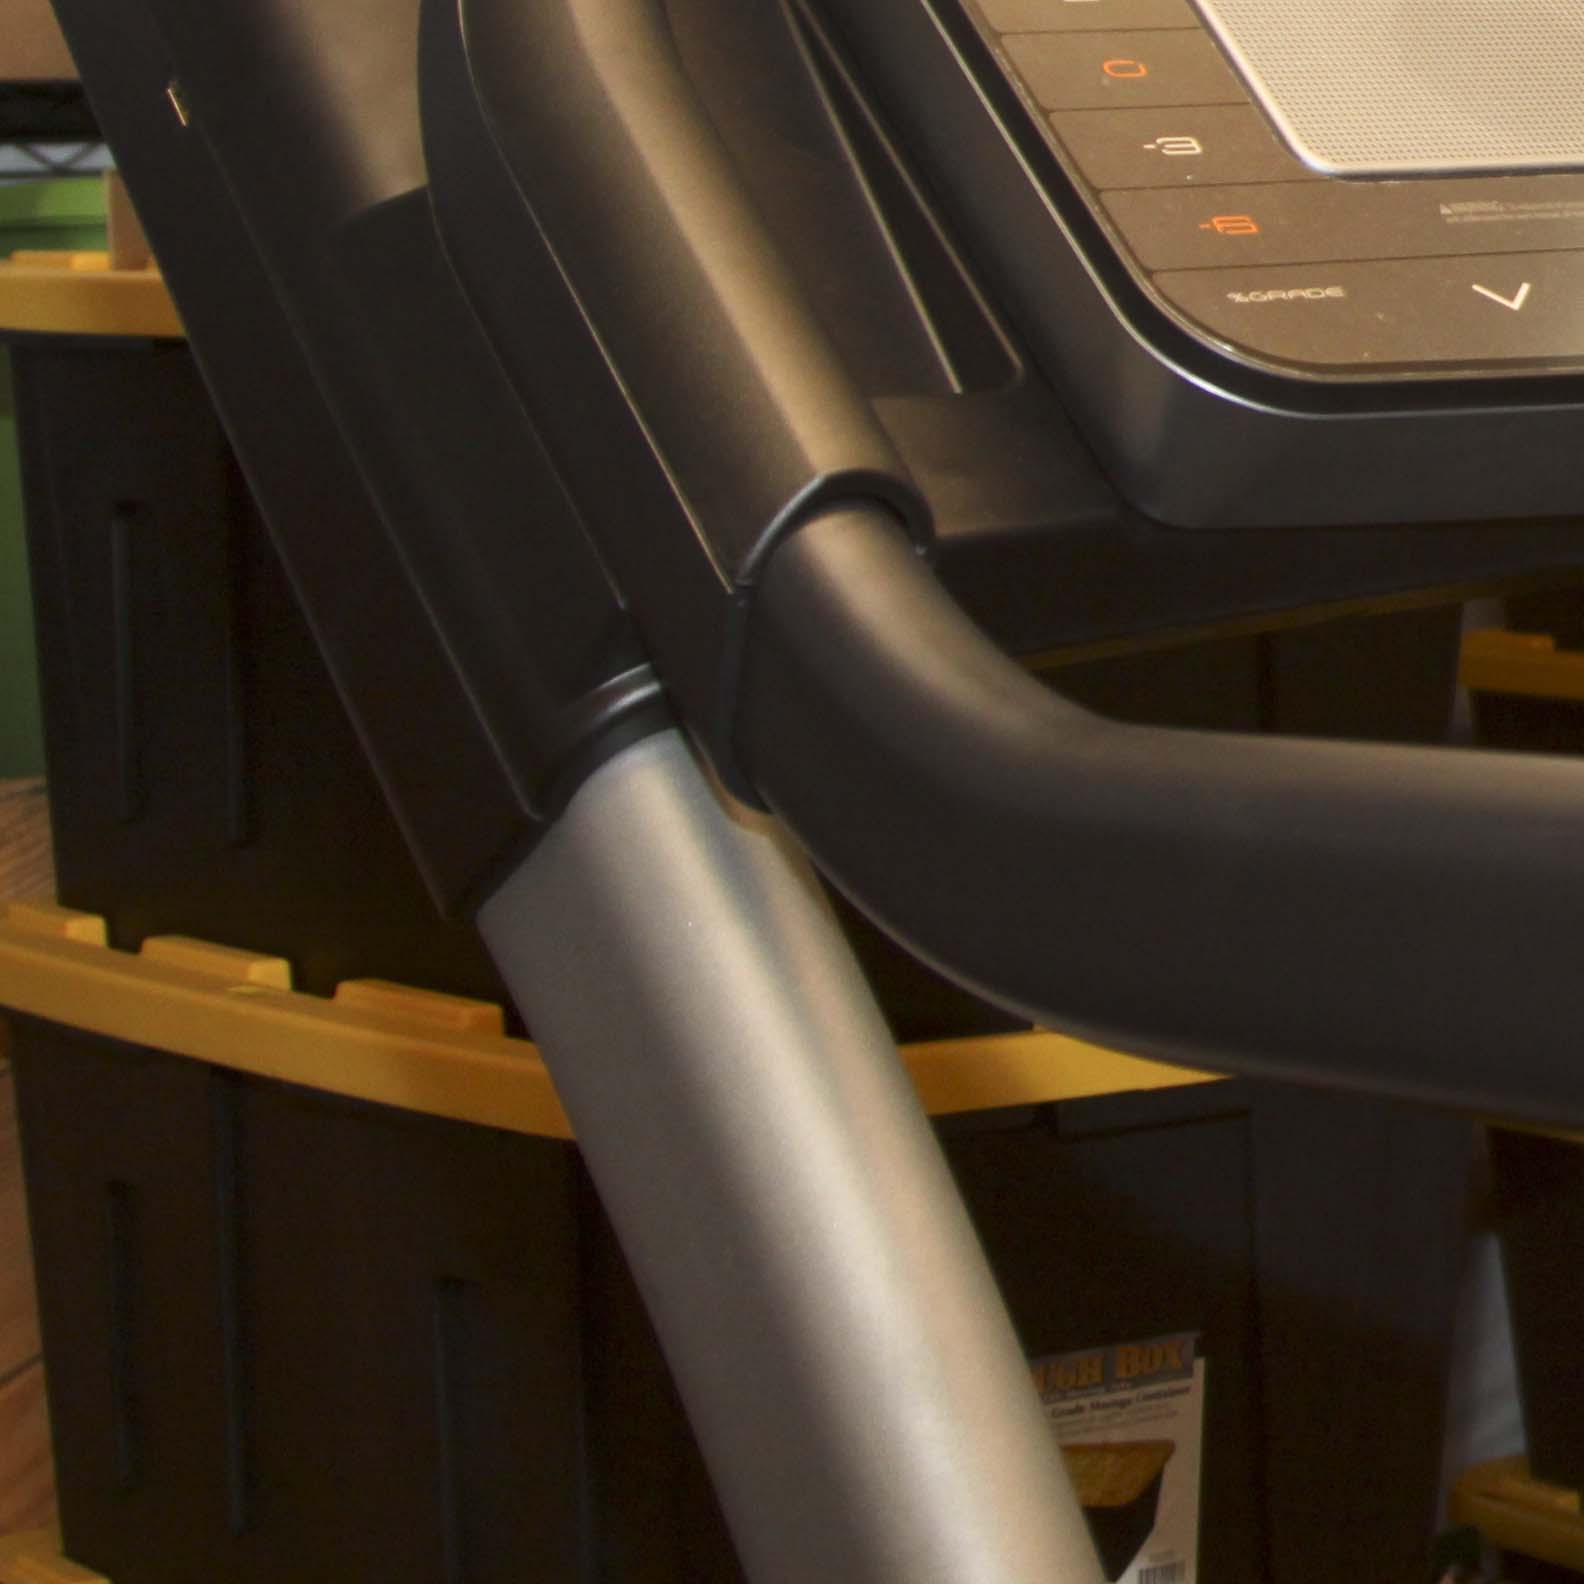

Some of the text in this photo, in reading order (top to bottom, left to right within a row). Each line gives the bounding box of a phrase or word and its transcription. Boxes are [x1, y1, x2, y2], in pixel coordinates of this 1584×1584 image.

[1103, 59, 1148, 79] 0
[1143, 136, 1203, 156] -3
[1200, 214, 1259, 236] -6
[1227, 285, 1349, 304] %GRADE
